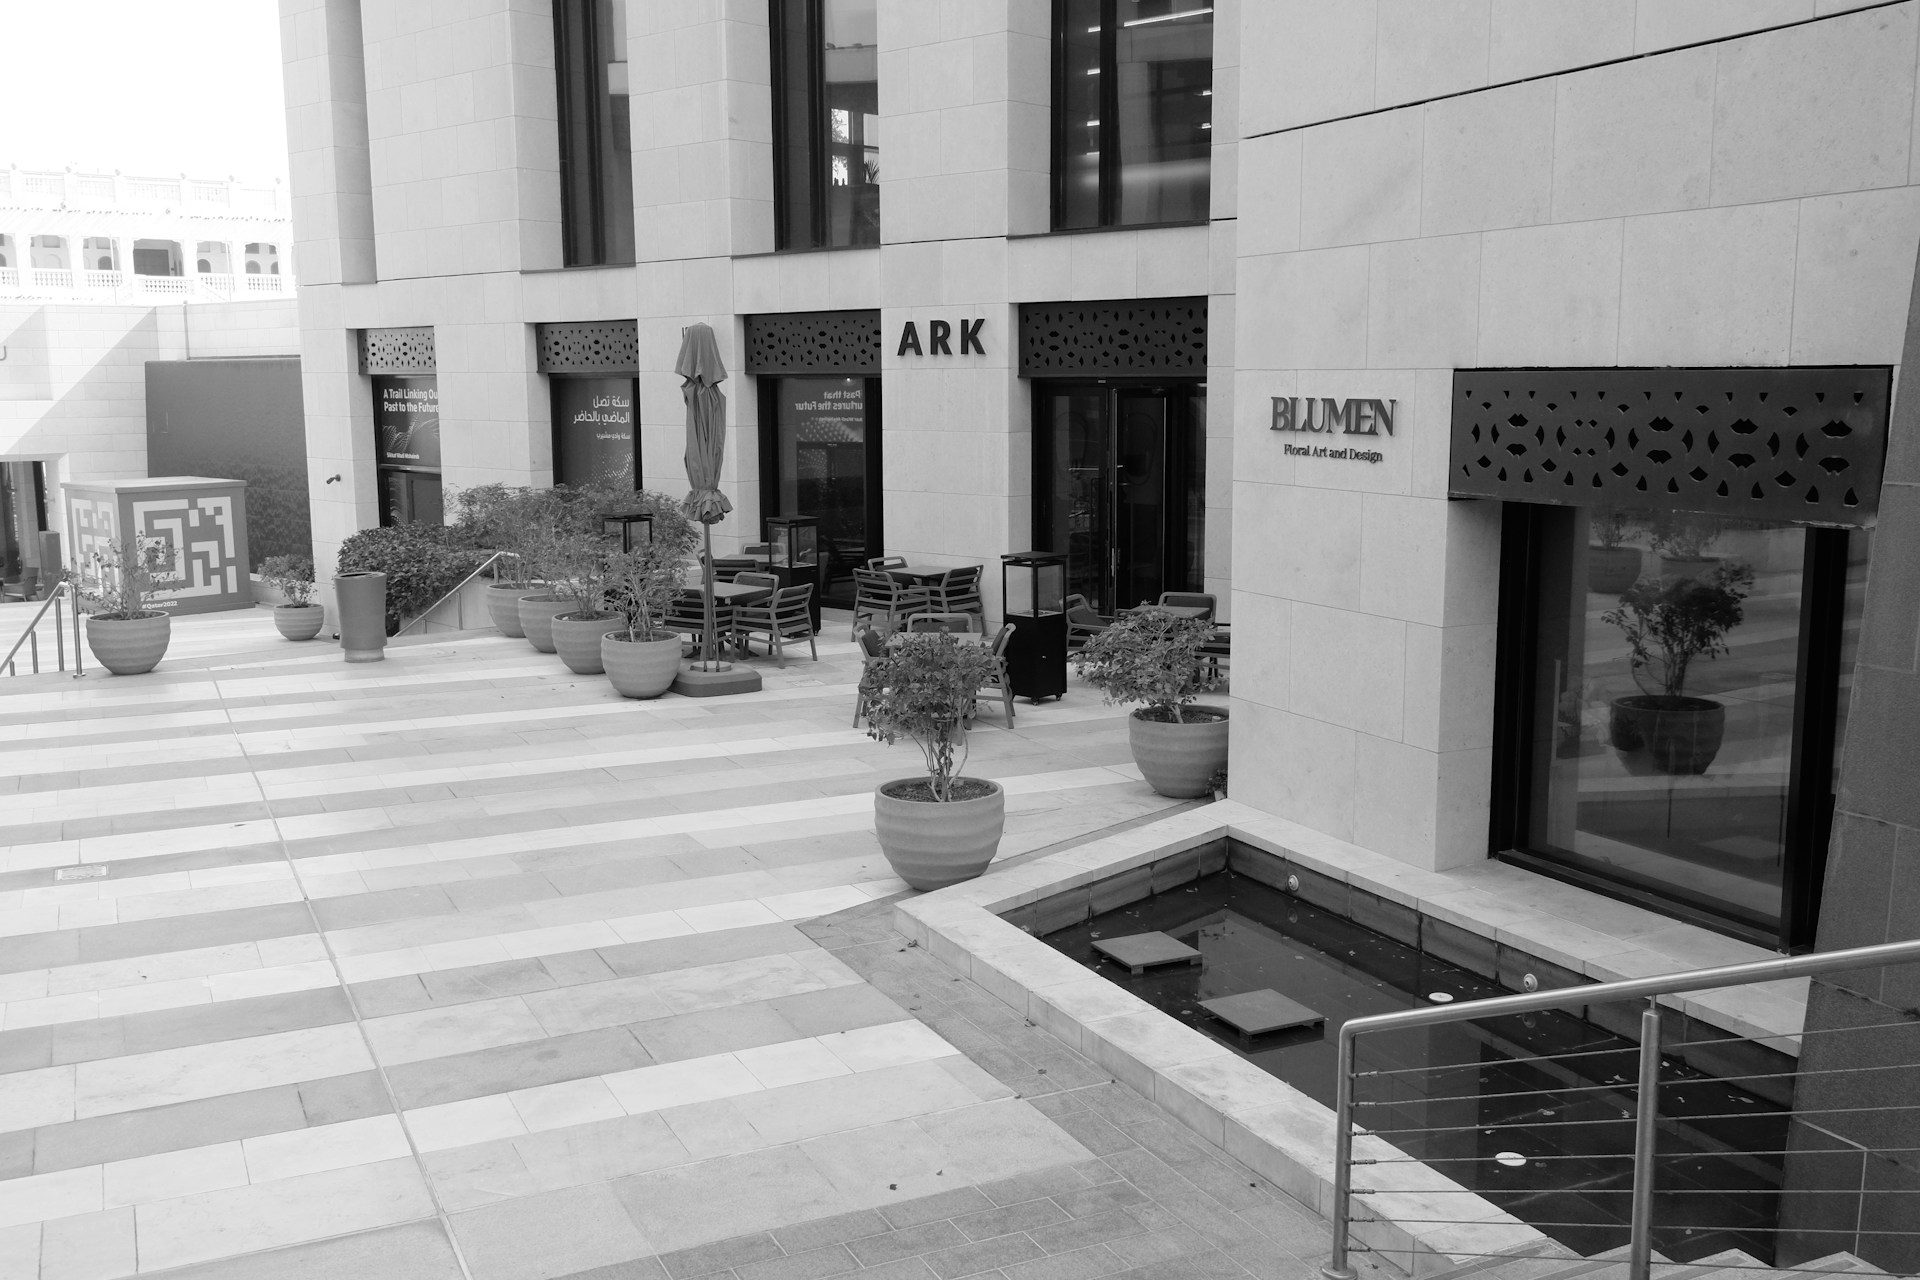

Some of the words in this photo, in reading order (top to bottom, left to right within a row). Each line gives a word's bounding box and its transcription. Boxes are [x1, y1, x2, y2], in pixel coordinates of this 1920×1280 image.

[897, 319, 986, 356] ARK
[384, 389, 389, 399] A
[389, 389, 403, 399] Trail
[404, 389, 428, 401] Linking
[593, 395, 610, 408] تصل
[612, 395, 630, 407] سكة
[384, 401, 398, 412] Past
[399, 402, 406, 412] to
[407, 402, 417, 412] the
[573, 410, 600, 425] بالحاضر
[602, 411, 630, 425] الماضي
[1270, 397, 1397, 436] BLUMEN
[1284, 444, 1311, 456] Floral
[1312, 446, 1328, 457] Art
[1329, 448, 1347, 459] and
[1349, 449, 1383, 463] Design
[141, 601, 178, 610] #Qatar2022
